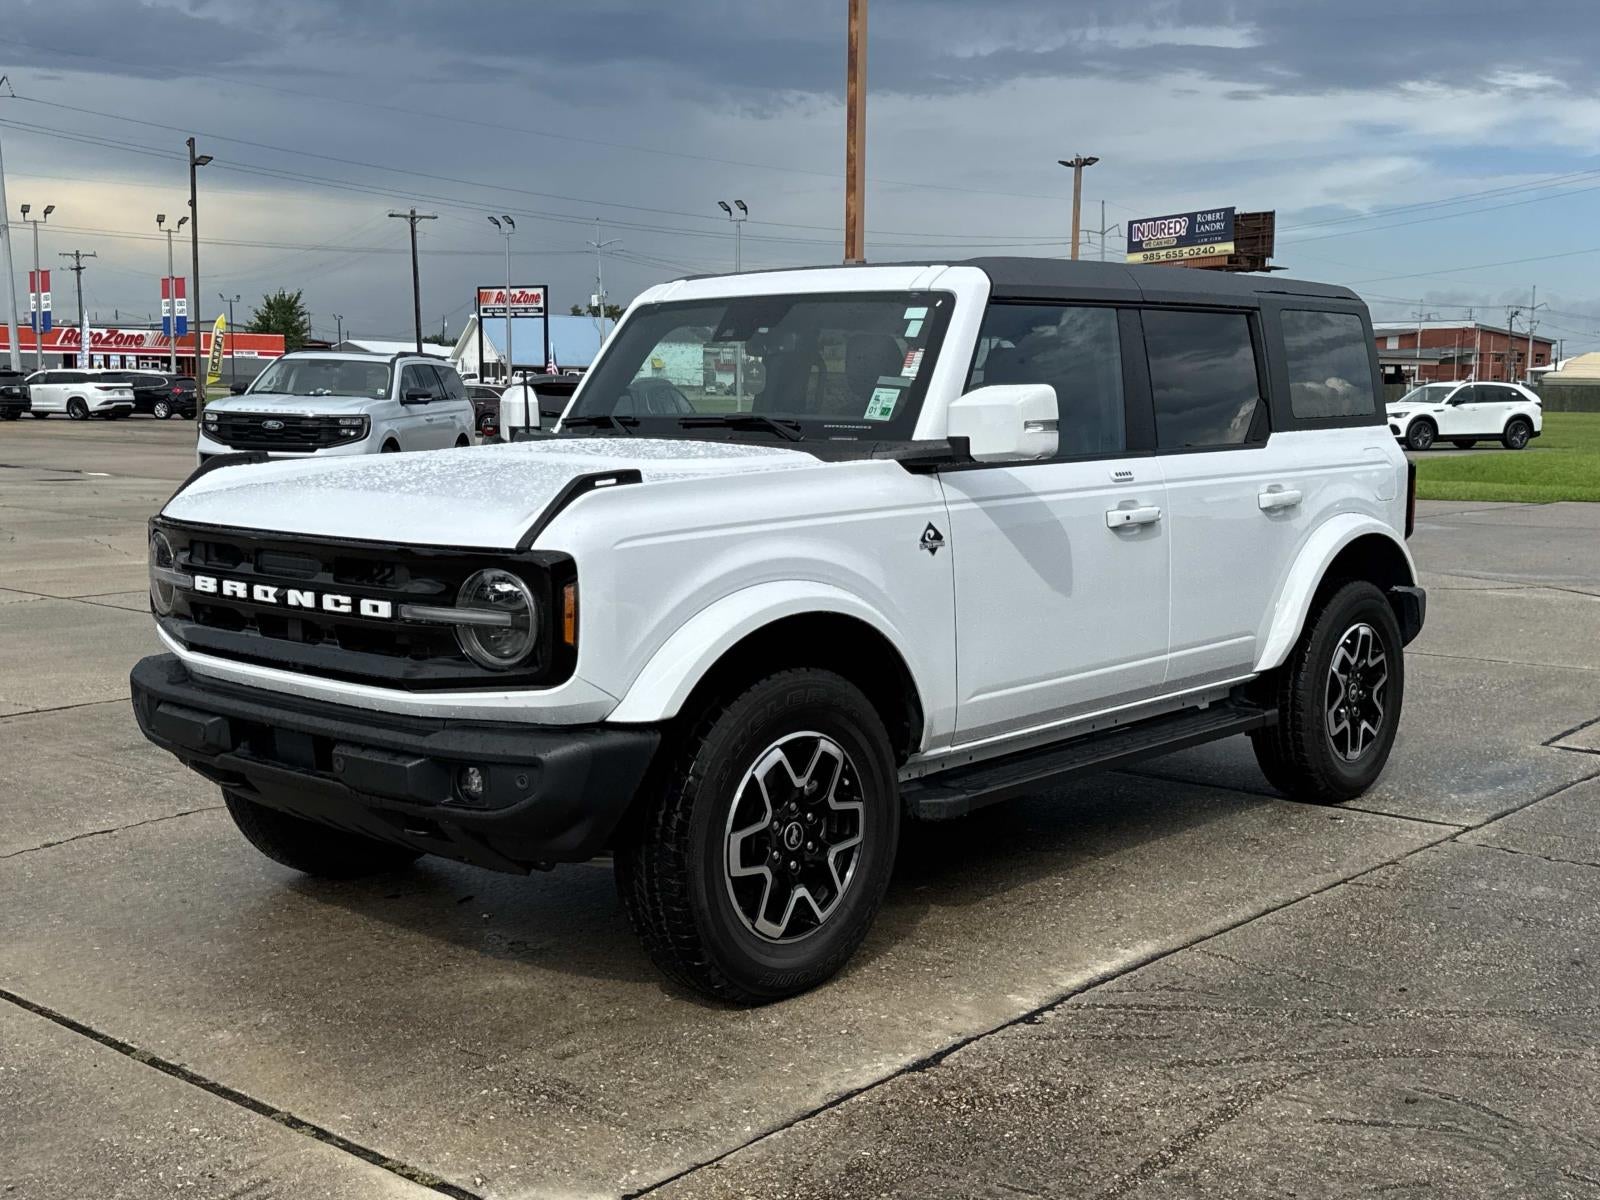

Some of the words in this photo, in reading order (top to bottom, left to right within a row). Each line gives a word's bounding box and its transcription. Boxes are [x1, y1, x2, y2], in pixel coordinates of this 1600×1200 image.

[1197, 212, 1224, 223] ROBERT
[1133, 217, 1188, 241] INJURED?
[1196, 222, 1225, 233] LANDRY
[1143, 246, 1216, 261] 985-655-0240
[211, 329, 224, 371] CARFAX
[194, 575, 391, 618] BRONCO
